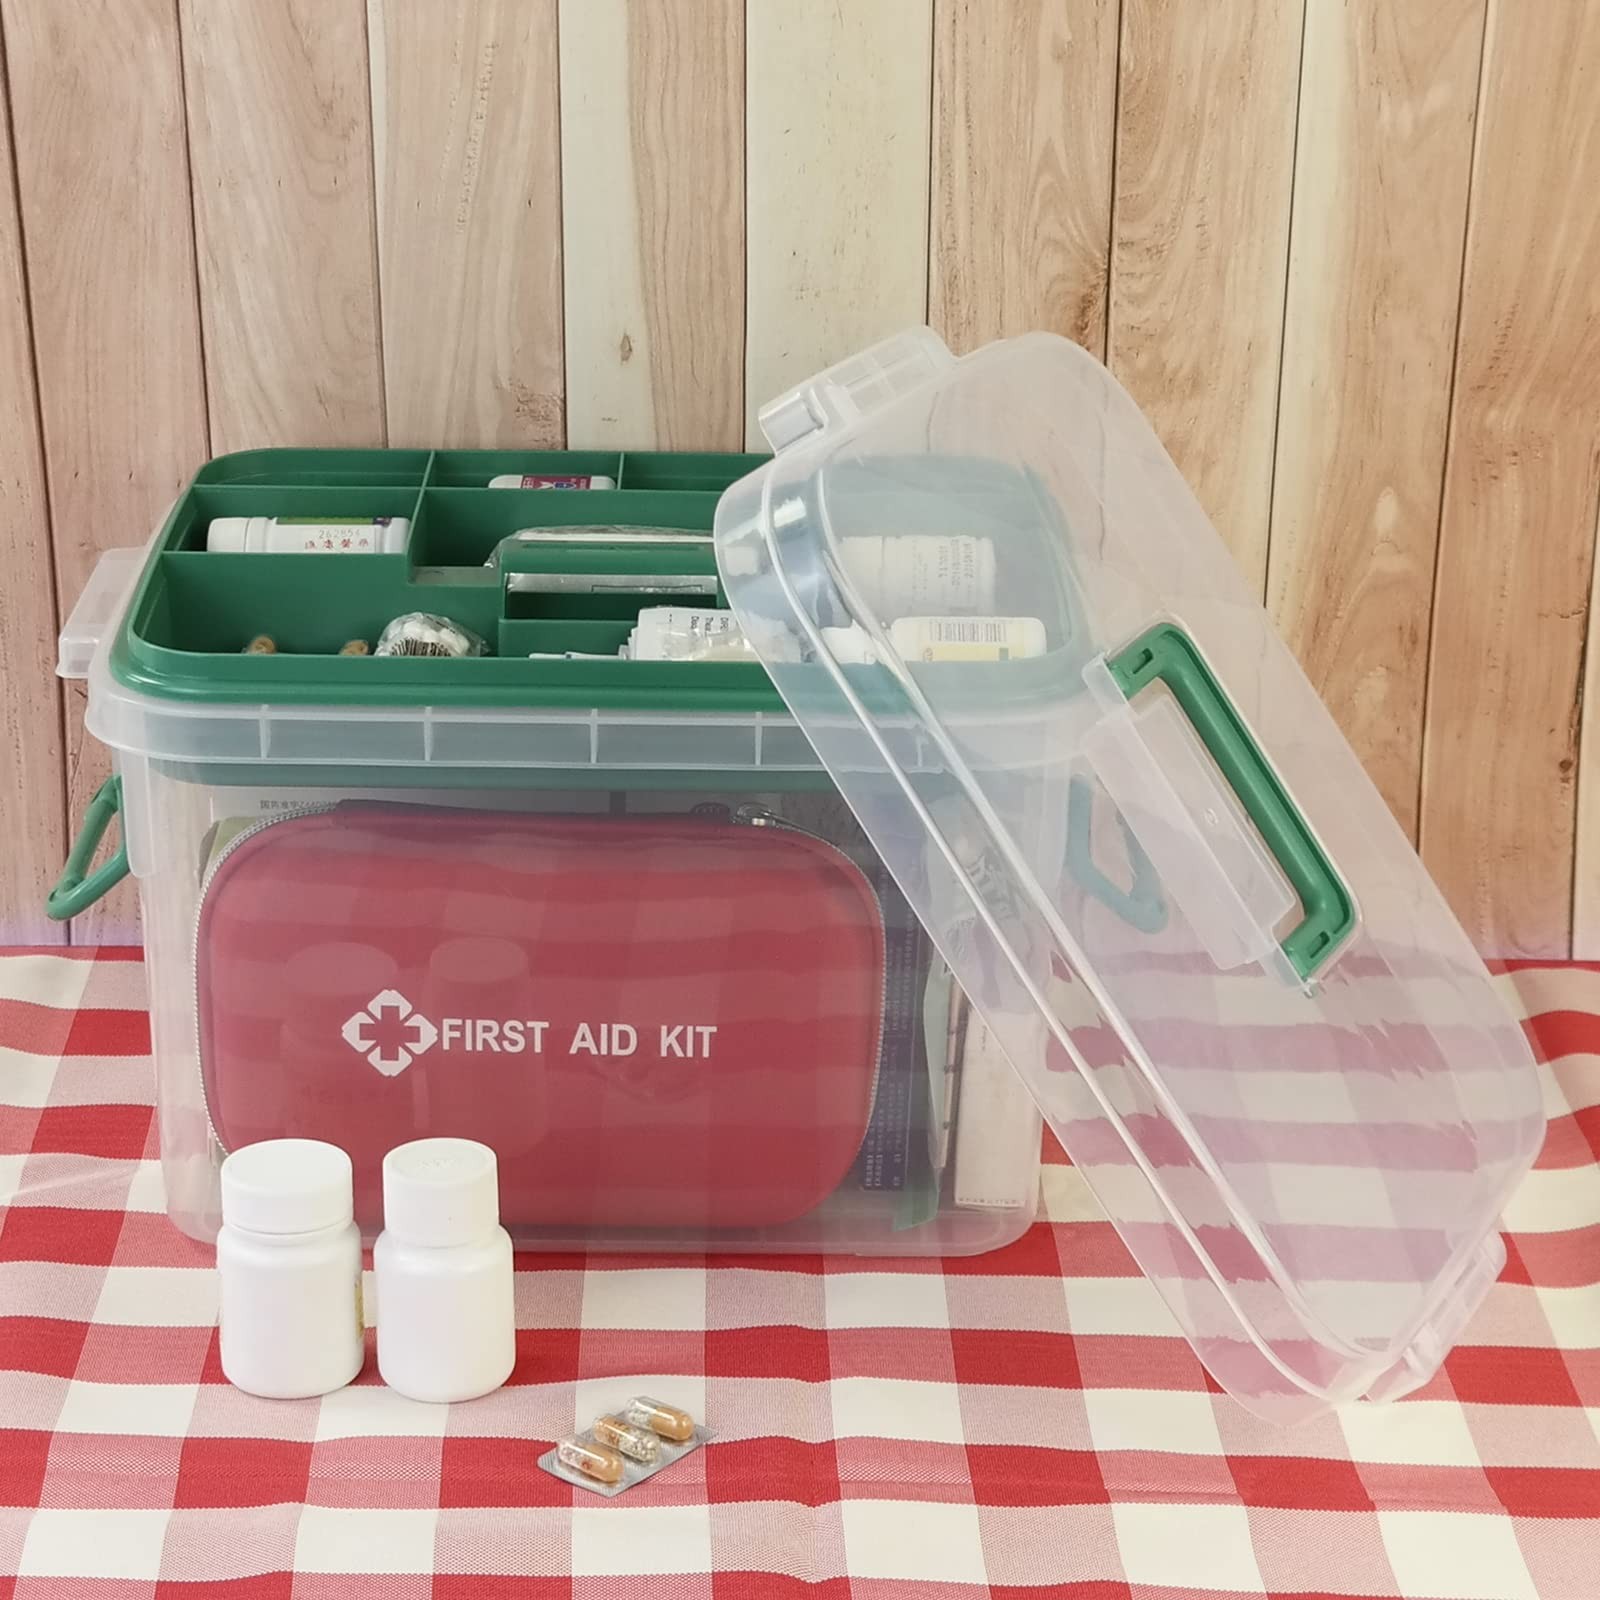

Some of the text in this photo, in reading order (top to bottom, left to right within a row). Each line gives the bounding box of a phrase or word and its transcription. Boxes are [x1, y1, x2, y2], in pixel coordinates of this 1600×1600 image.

[441, 1018, 718, 1058] FIRST AID KIT
